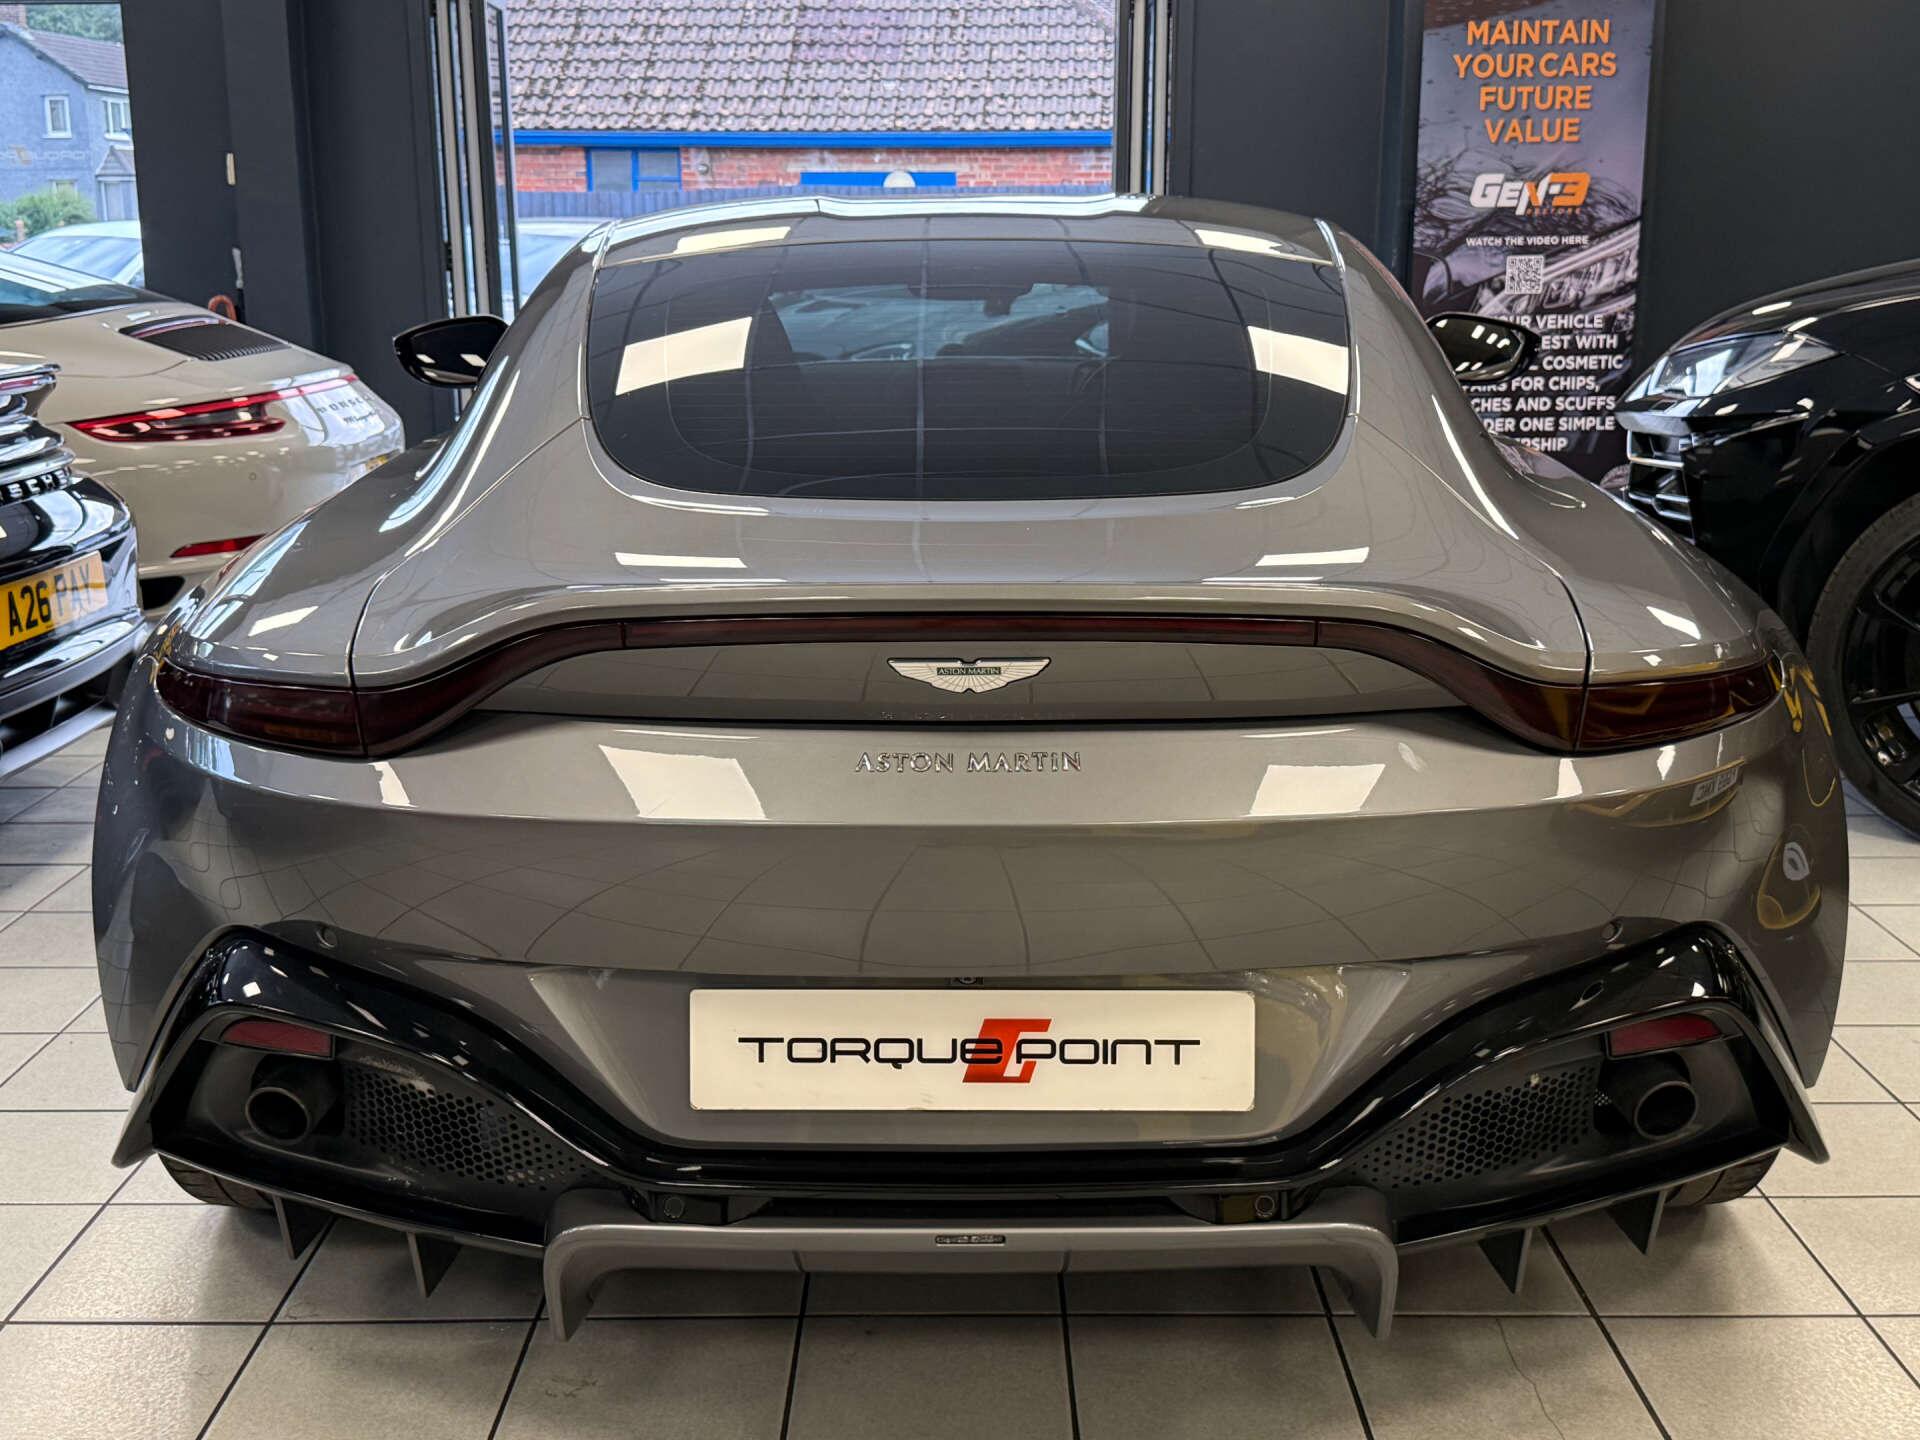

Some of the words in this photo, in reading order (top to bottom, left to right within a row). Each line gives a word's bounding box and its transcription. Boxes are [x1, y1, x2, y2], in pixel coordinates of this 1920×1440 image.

[1467, 19, 1611, 45] MAINTAIN
[1453, 53, 1535, 78] YOUR
[1539, 52, 1617, 77] CARS
[1479, 85, 1593, 111] FUTURE
[1484, 118, 1581, 143] VALUE
[1466, 236, 1503, 247] WATCH
[1505, 236, 1525, 246] THE
[1526, 236, 1560, 246] VIDEO
[1561, 235, 1590, 245] HERE
[1536, 314, 1603, 329] VEHICLE
[1540, 335, 1571, 350] EST
[1575, 335, 1618, 349] WITH
[1542, 355, 1624, 370] COSMETIC
[1511, 377, 1545, 391] FOR
[1549, 376, 1600, 392] CHIPS,
[1515, 397, 1551, 412] AND
[1555, 396, 1616, 411] SCUFFS
[1520, 417, 1555, 432] ONE
[1559, 416, 1616, 431] SIMPLE
[7, 580, 52, 637] A26
[938, 667, 966, 676] ASTON
[968, 667, 1000, 676] MARTIN
[855, 752, 953, 773] ASTON
[966, 751, 1082, 773] MARTIN
